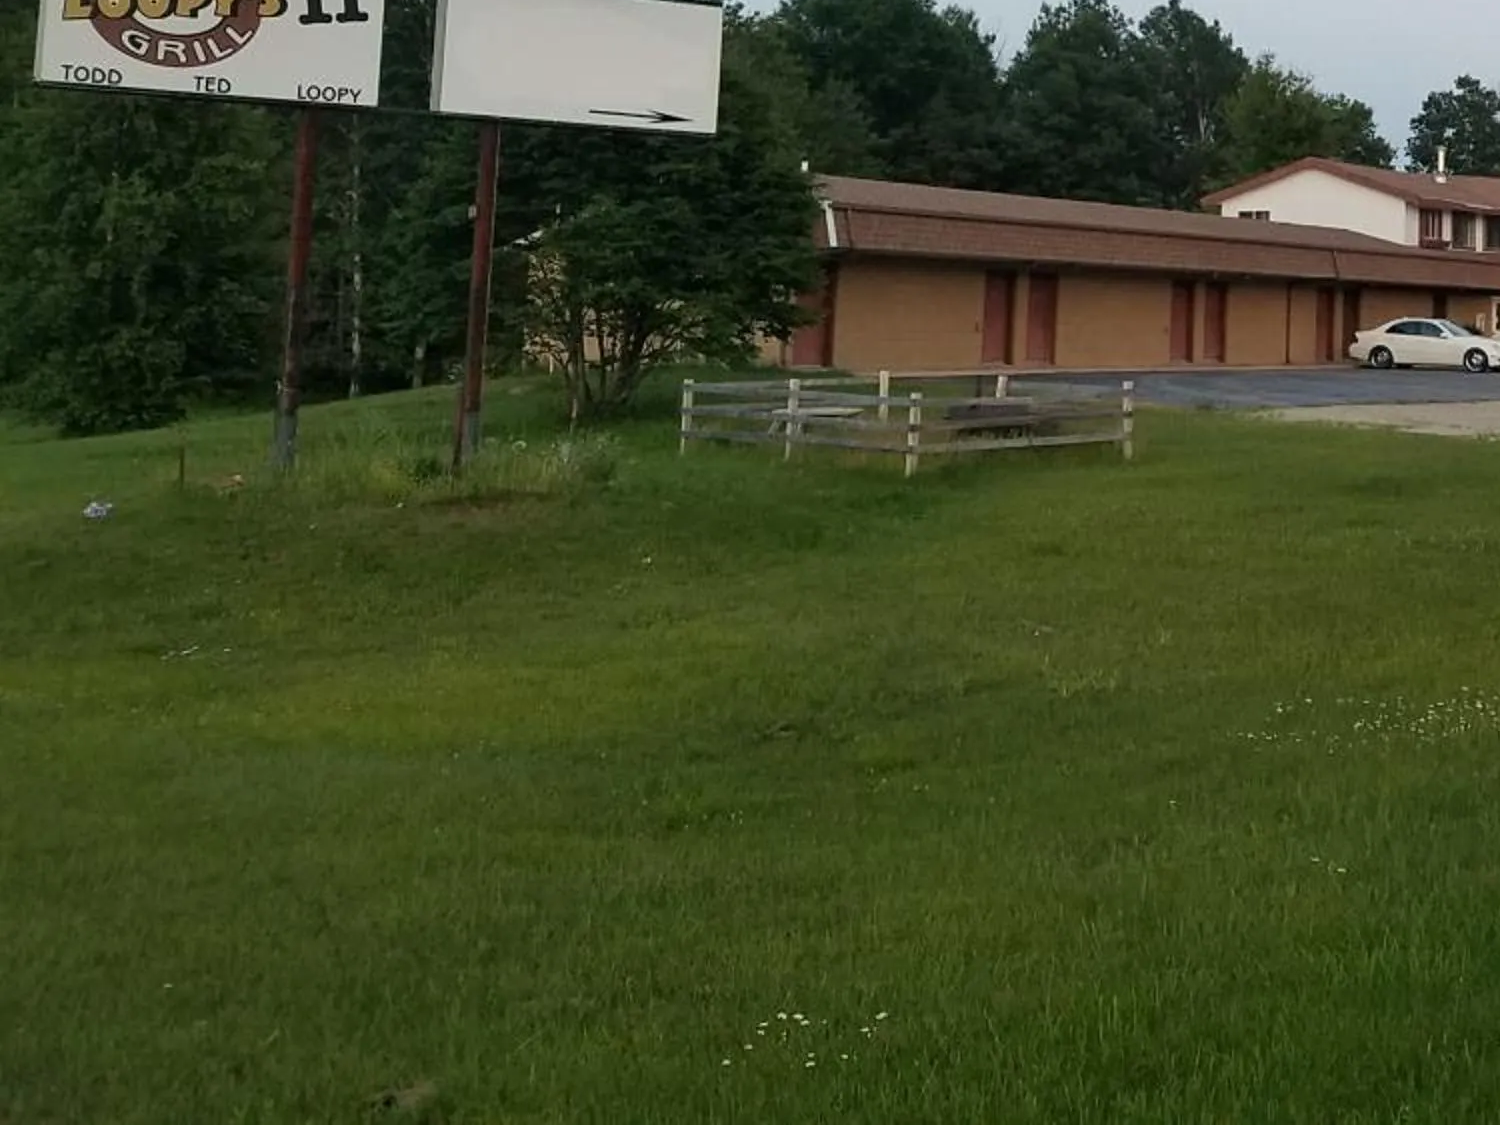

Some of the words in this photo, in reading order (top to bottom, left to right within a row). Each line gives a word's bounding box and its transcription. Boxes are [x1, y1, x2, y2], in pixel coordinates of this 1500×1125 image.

[121, 26, 253, 64] GRILL
[61, 64, 123, 85] TODD
[193, 75, 232, 94] TED
[297, 85, 363, 104] LOOPY
